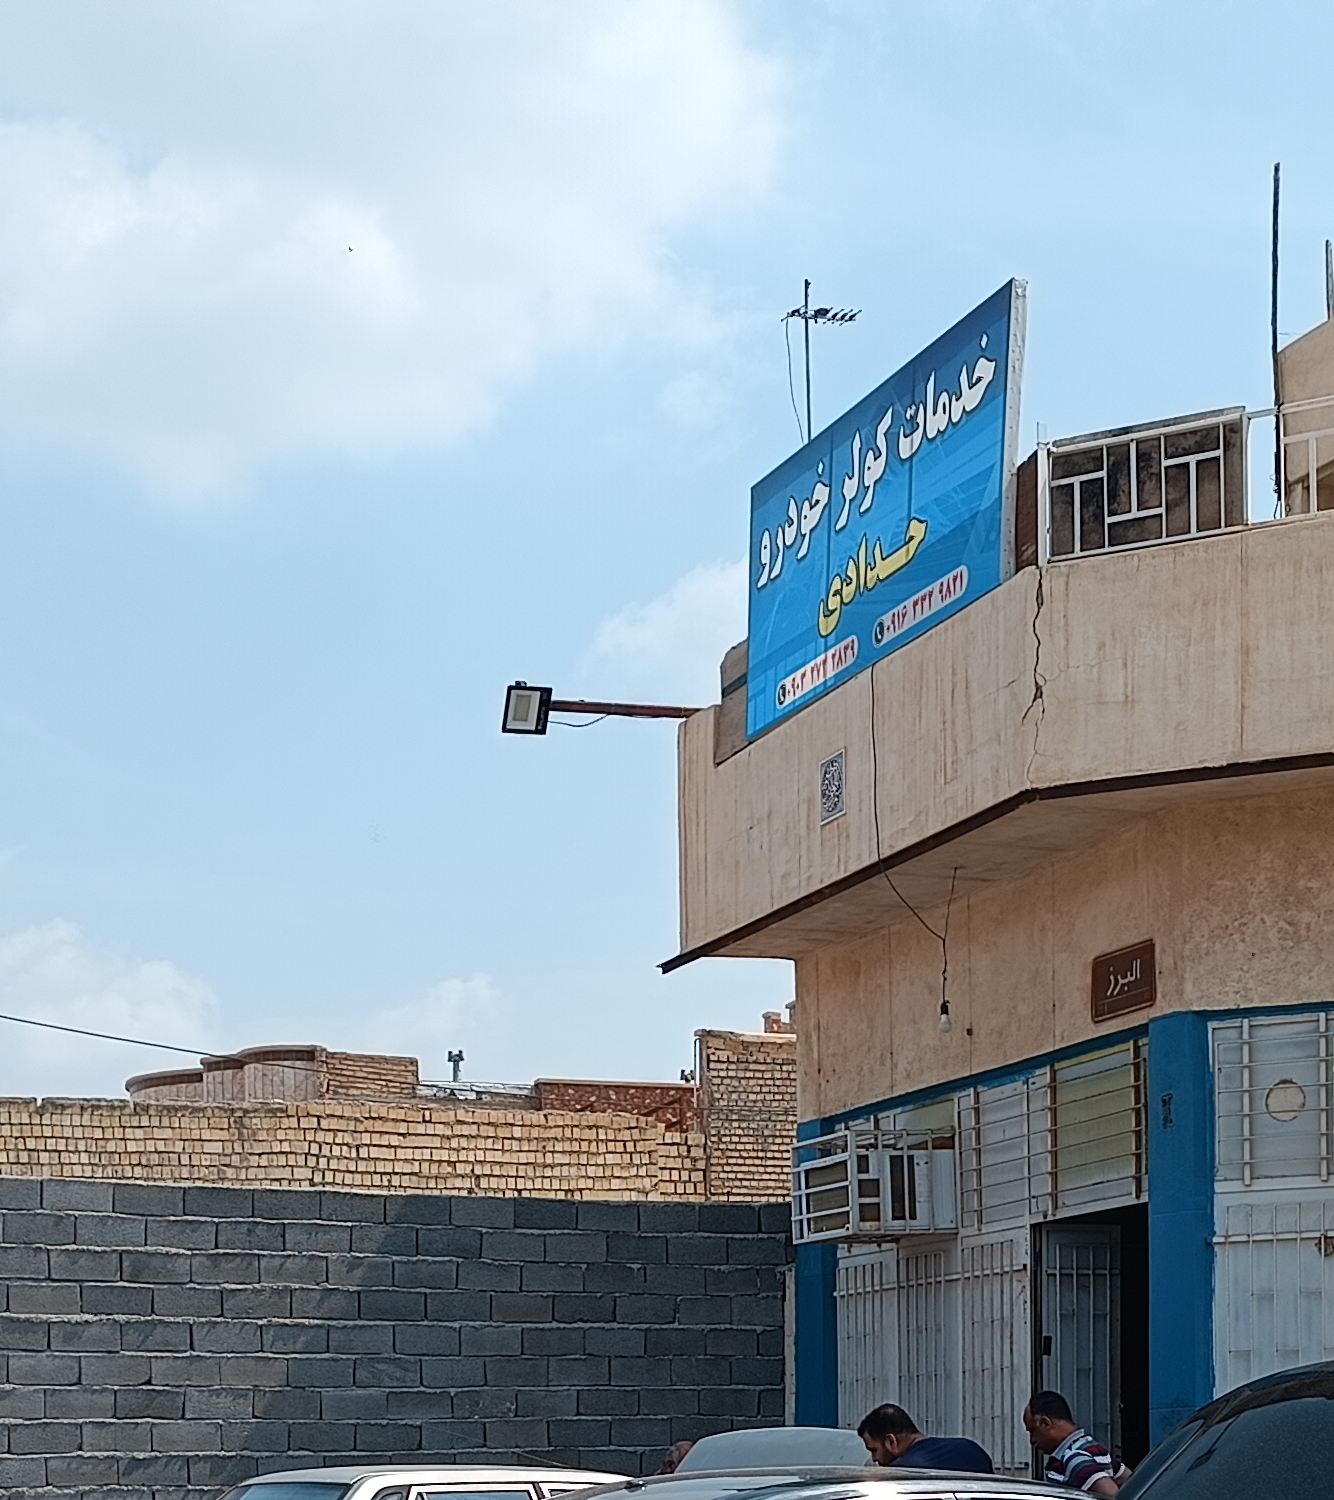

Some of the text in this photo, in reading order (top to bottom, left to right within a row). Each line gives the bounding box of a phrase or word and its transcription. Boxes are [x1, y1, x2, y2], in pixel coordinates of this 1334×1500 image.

[756, 332, 997, 589] خدمات کولر خودرو
[817, 516, 928, 638] حدادی
[1107, 958, 1141, 996] البرز
